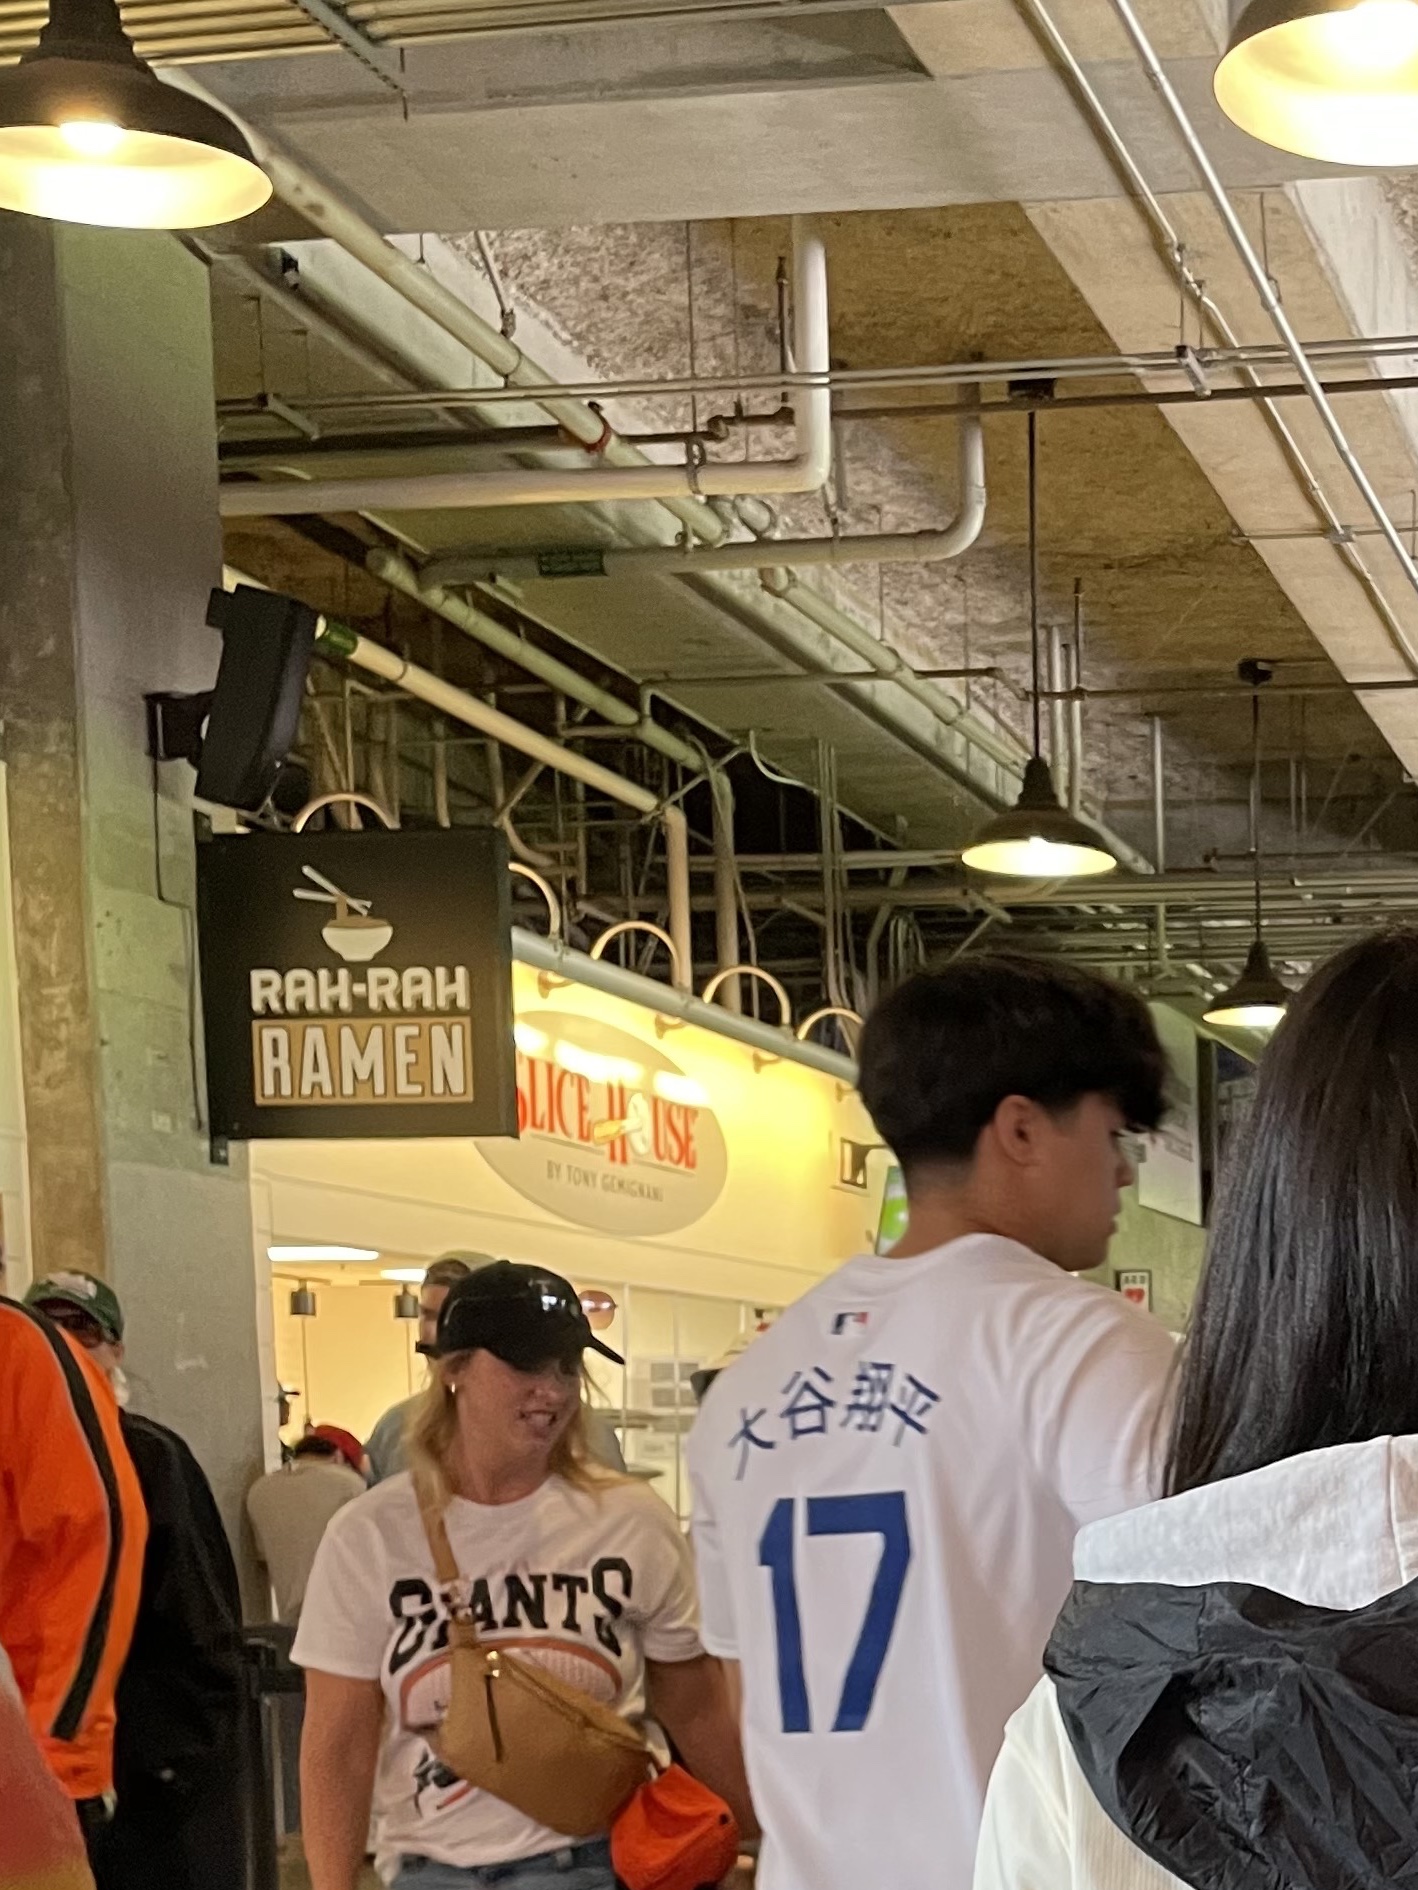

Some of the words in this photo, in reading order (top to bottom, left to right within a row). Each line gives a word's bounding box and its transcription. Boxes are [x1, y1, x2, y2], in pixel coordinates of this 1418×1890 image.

[250, 965, 470, 1015] RAH-RAH
[261, 1024, 466, 1097] RAMEN
[546, 1159, 562, 1180] BY
[567, 1163, 597, 1188] TONY
[758, 1490, 911, 1734] 17
